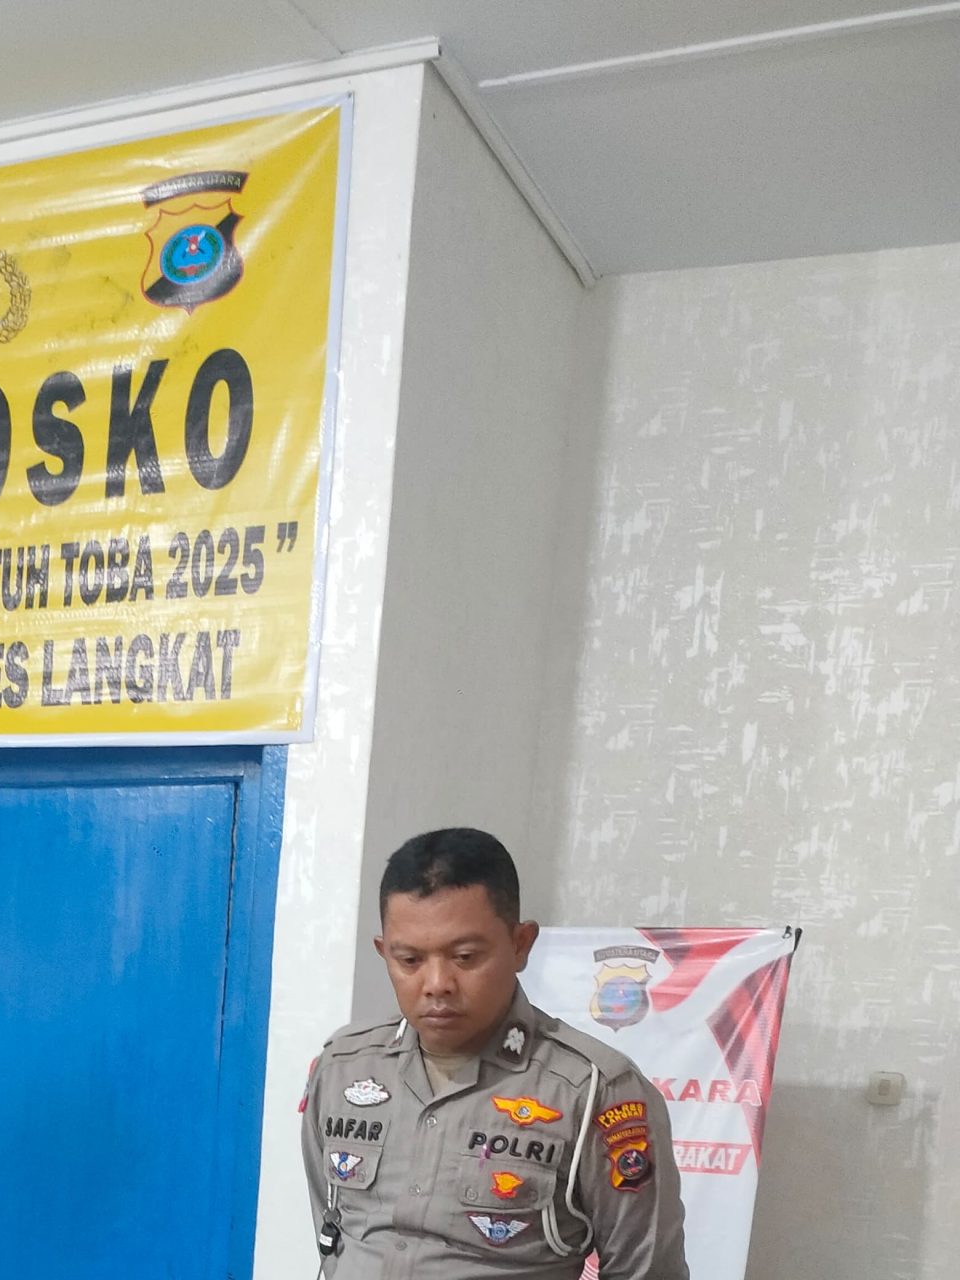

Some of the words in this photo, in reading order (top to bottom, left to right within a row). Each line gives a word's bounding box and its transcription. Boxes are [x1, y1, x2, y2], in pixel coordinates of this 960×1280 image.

[59, 535, 155, 608] TOBA
[40, 628, 240, 706] LANGKAT
[325, 1116, 383, 1142] SAFAR
[598, 1103, 643, 1124] POLRES
[468, 1130, 555, 1165] POLRI
